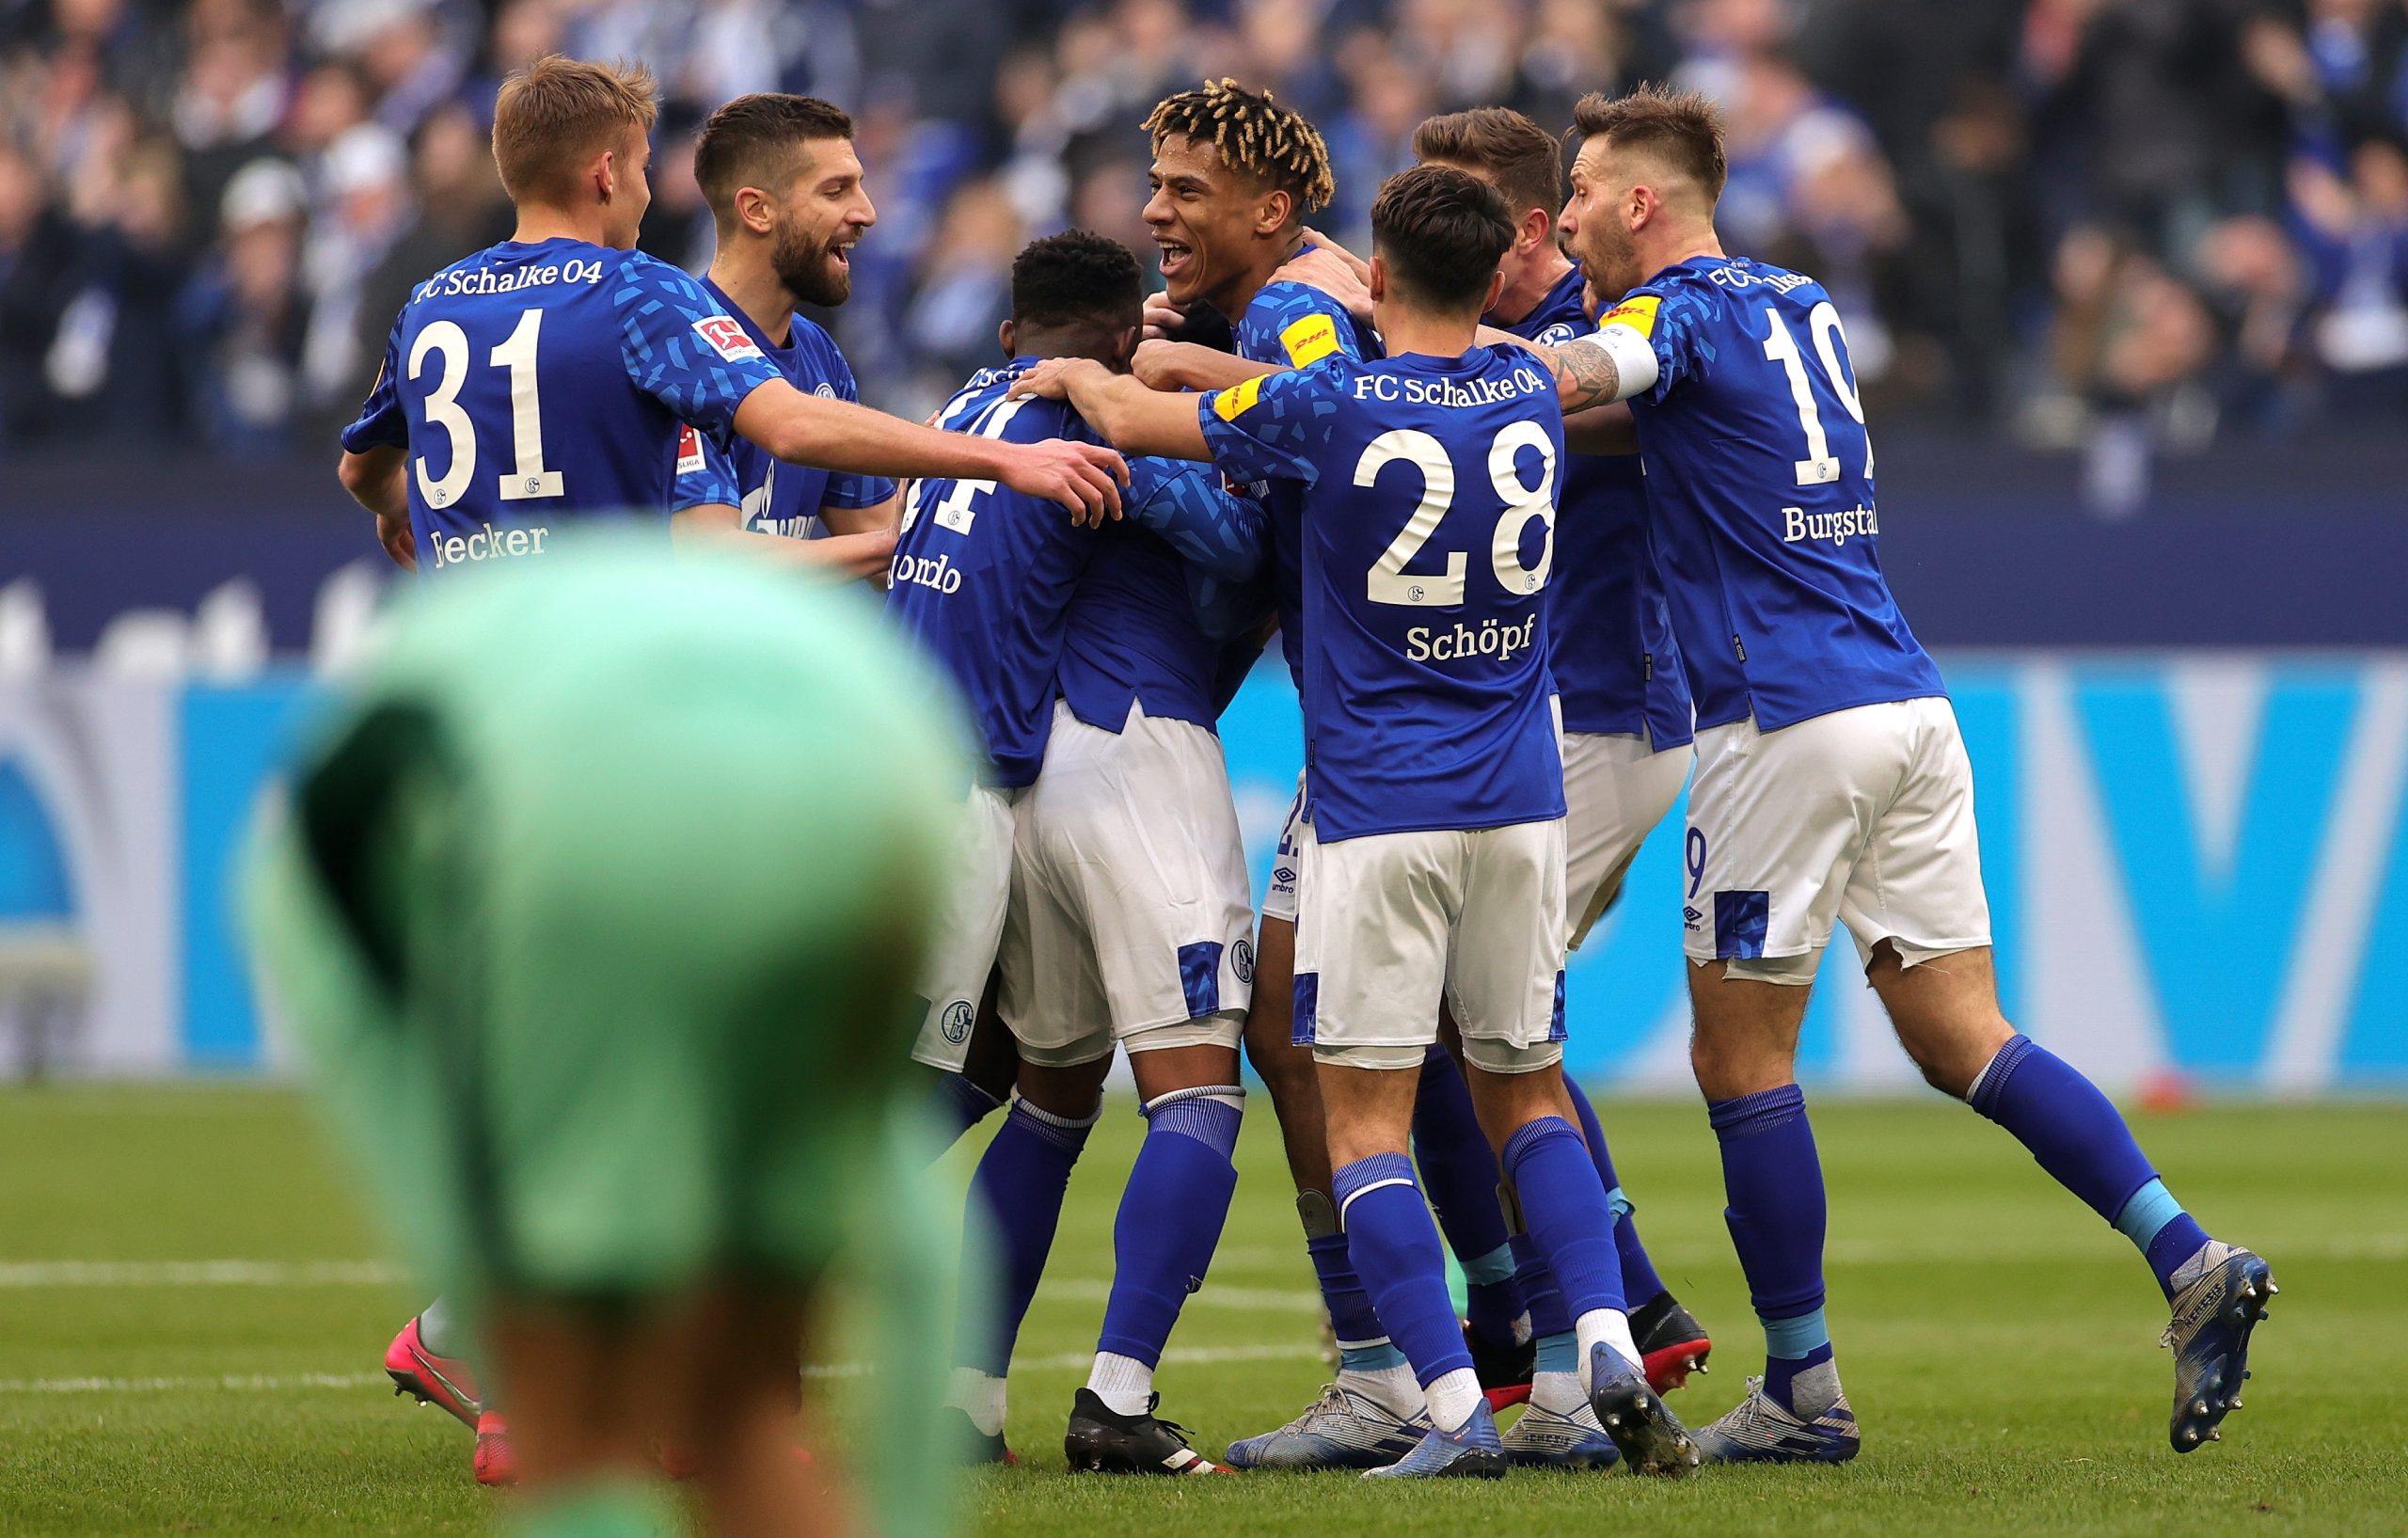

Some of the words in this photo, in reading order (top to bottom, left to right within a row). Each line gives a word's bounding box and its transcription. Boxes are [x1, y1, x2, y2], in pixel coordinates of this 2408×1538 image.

[444, 260, 559, 296] Schalke
[562, 259, 603, 285] 04
[407, 308, 564, 510] 31
[1353, 374, 1401, 402] FC
[1403, 376, 1517, 408] Schalke
[1513, 367, 1547, 394] 04
[1762, 301, 1876, 486] 19
[1353, 420, 1557, 608] 28
[430, 522, 549, 569] Becker
[1406, 612, 1537, 662] Schöpf
